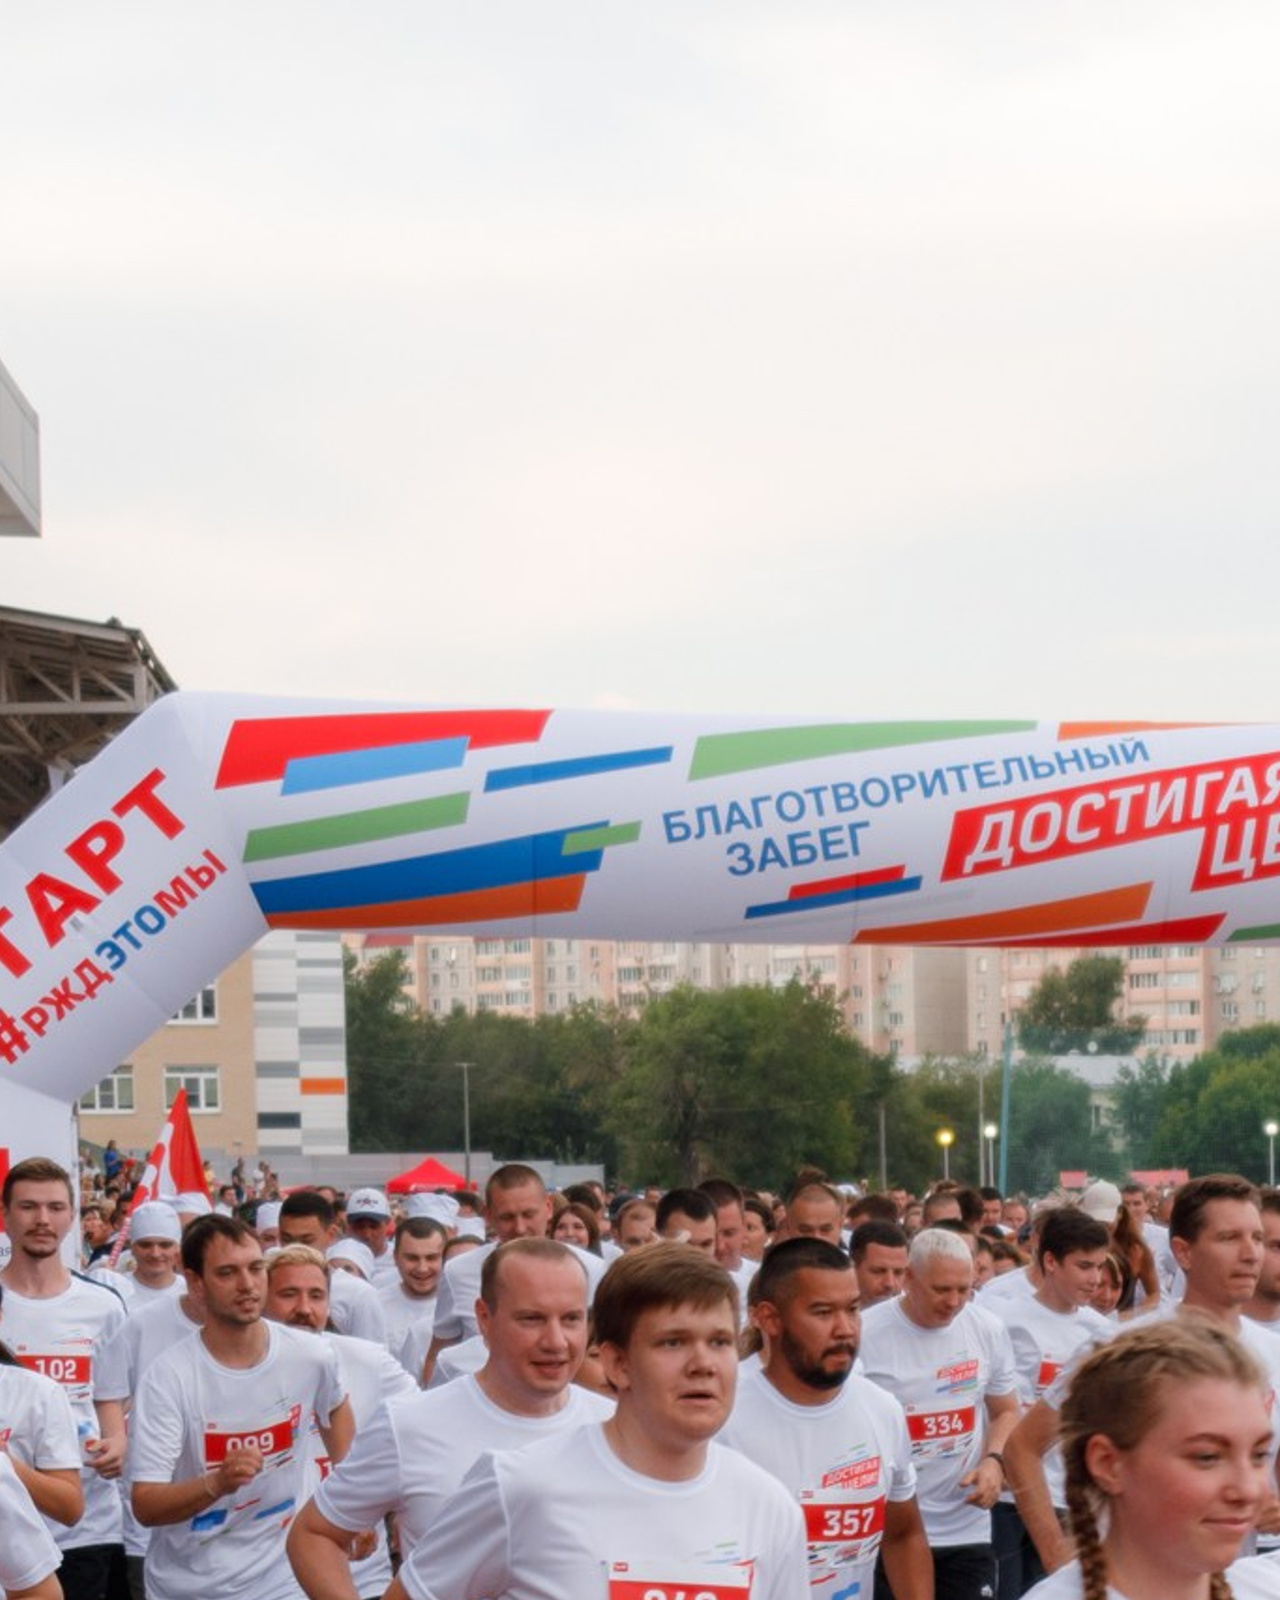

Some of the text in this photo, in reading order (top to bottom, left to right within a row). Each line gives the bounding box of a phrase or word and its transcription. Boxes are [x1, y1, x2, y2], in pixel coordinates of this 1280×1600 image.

[662, 736, 1150, 844] БЛАГОТВОРИТЕЛЬНЫЙ
[726, 821, 870, 876] ЗАБЕГ
[0, 767, 186, 979] ТАРТ
[35, 1359, 77, 1381] 102
[923, 1413, 964, 1437] 334
[822, 1506, 876, 1537] 357
